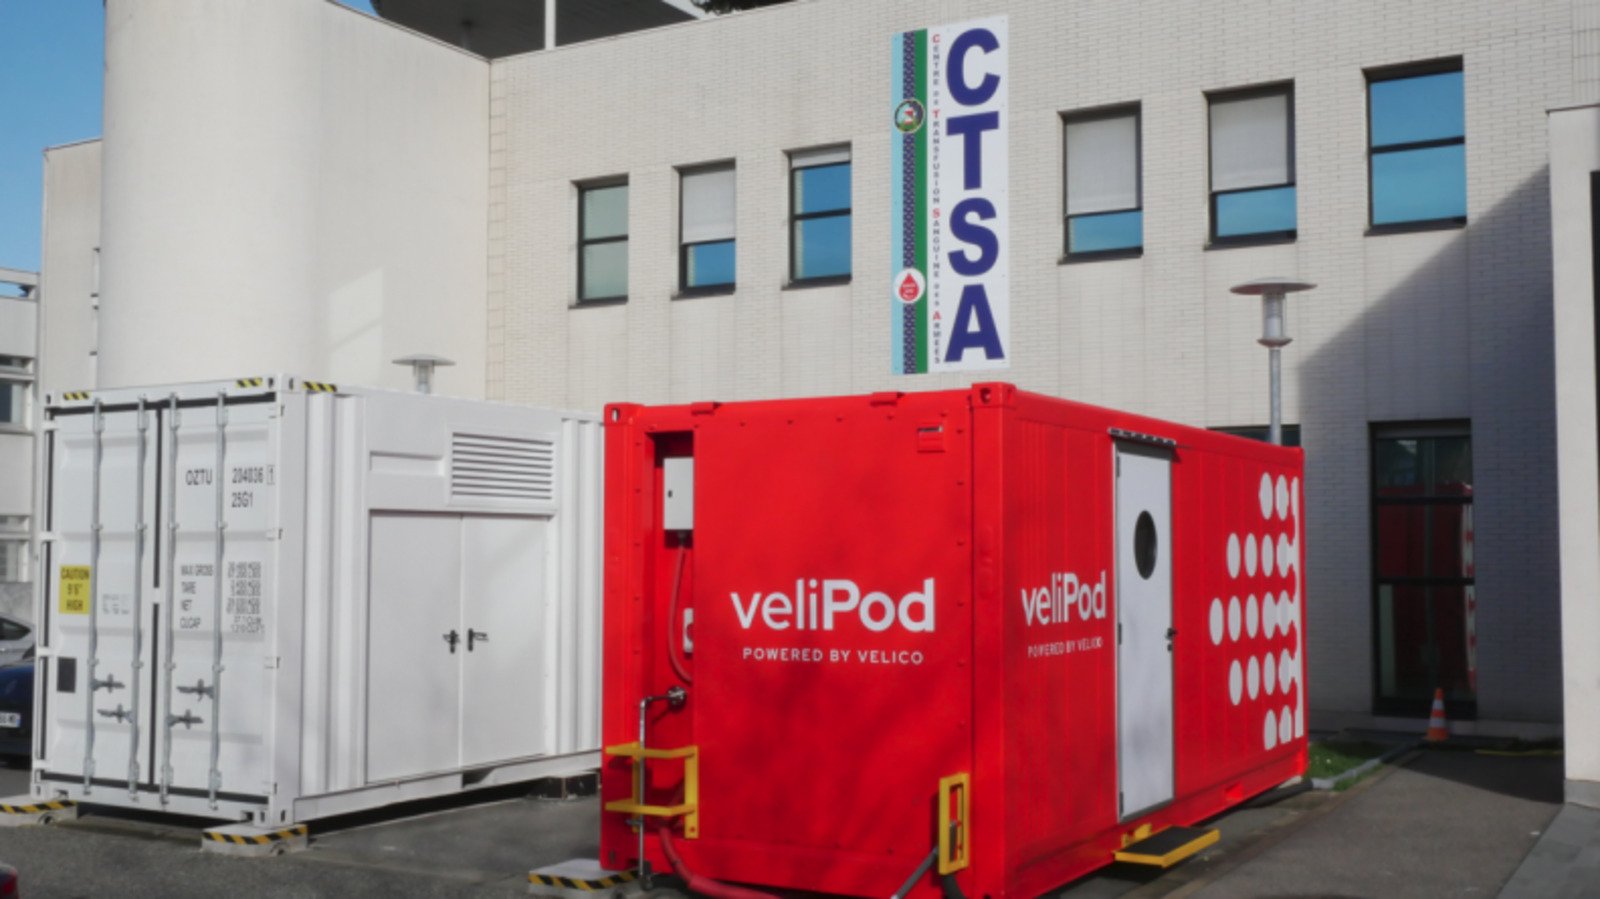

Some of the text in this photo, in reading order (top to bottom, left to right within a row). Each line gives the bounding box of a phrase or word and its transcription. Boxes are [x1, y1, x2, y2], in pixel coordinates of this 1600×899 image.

[932, 34, 941, 86] CENTRE
[932, 109, 941, 204] TRANSFUSION
[944, 28, 1005, 362] CTSA
[932, 208, 941, 279] SANGUINE
[185, 468, 213, 486] OZTU
[231, 491, 253, 508] 25G1
[61, 567, 89, 581] CAUTION
[66, 600, 84, 612] HIGH
[730, 577, 935, 632] veliPod
[1021, 570, 1106, 627] veliPod
[743, 647, 924, 665] POWERED BY VELICO
[1027, 641, 1065, 658] POWERED
[1066, 639, 1076, 654] BY
